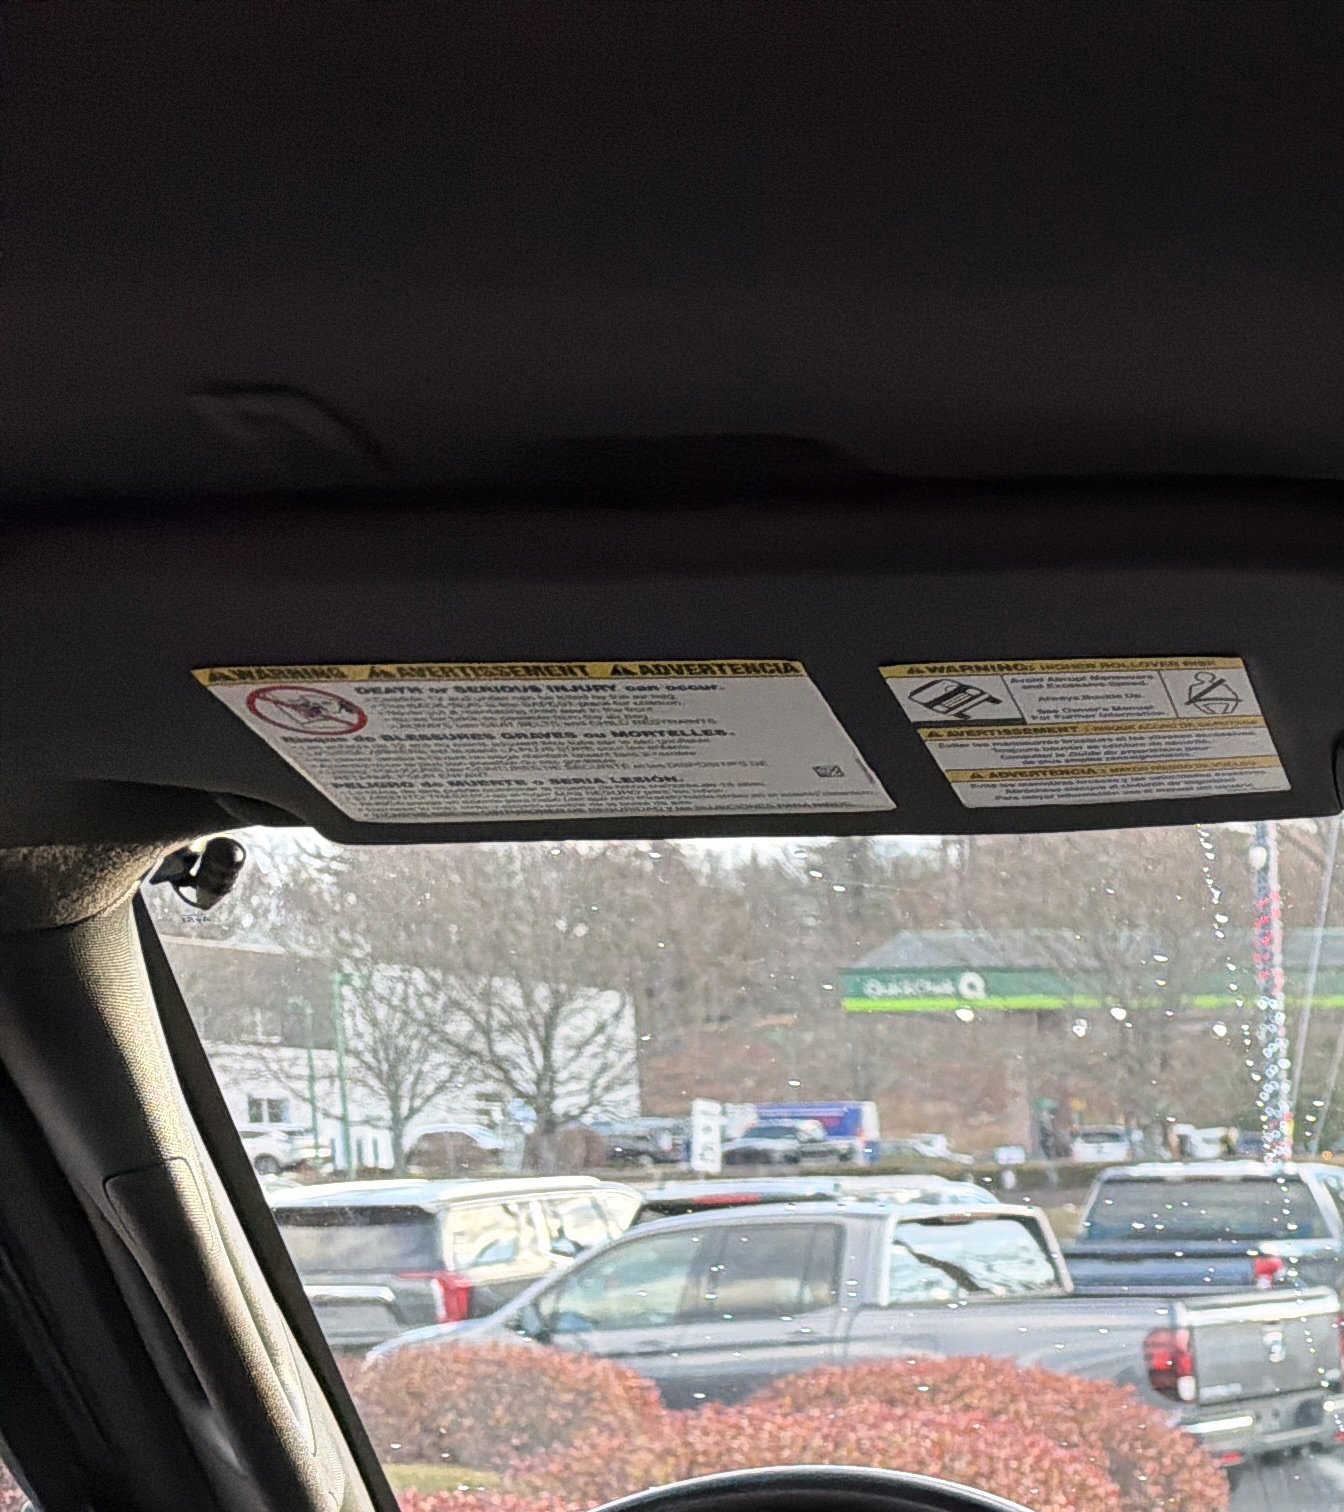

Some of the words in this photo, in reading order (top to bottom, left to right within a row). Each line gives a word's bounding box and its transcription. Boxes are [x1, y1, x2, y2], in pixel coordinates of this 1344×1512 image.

[232, 667, 347, 680] WARNING
[397, 664, 591, 679] AVERTISSEMENT
[638, 661, 800, 676] ADVERTENCIA
